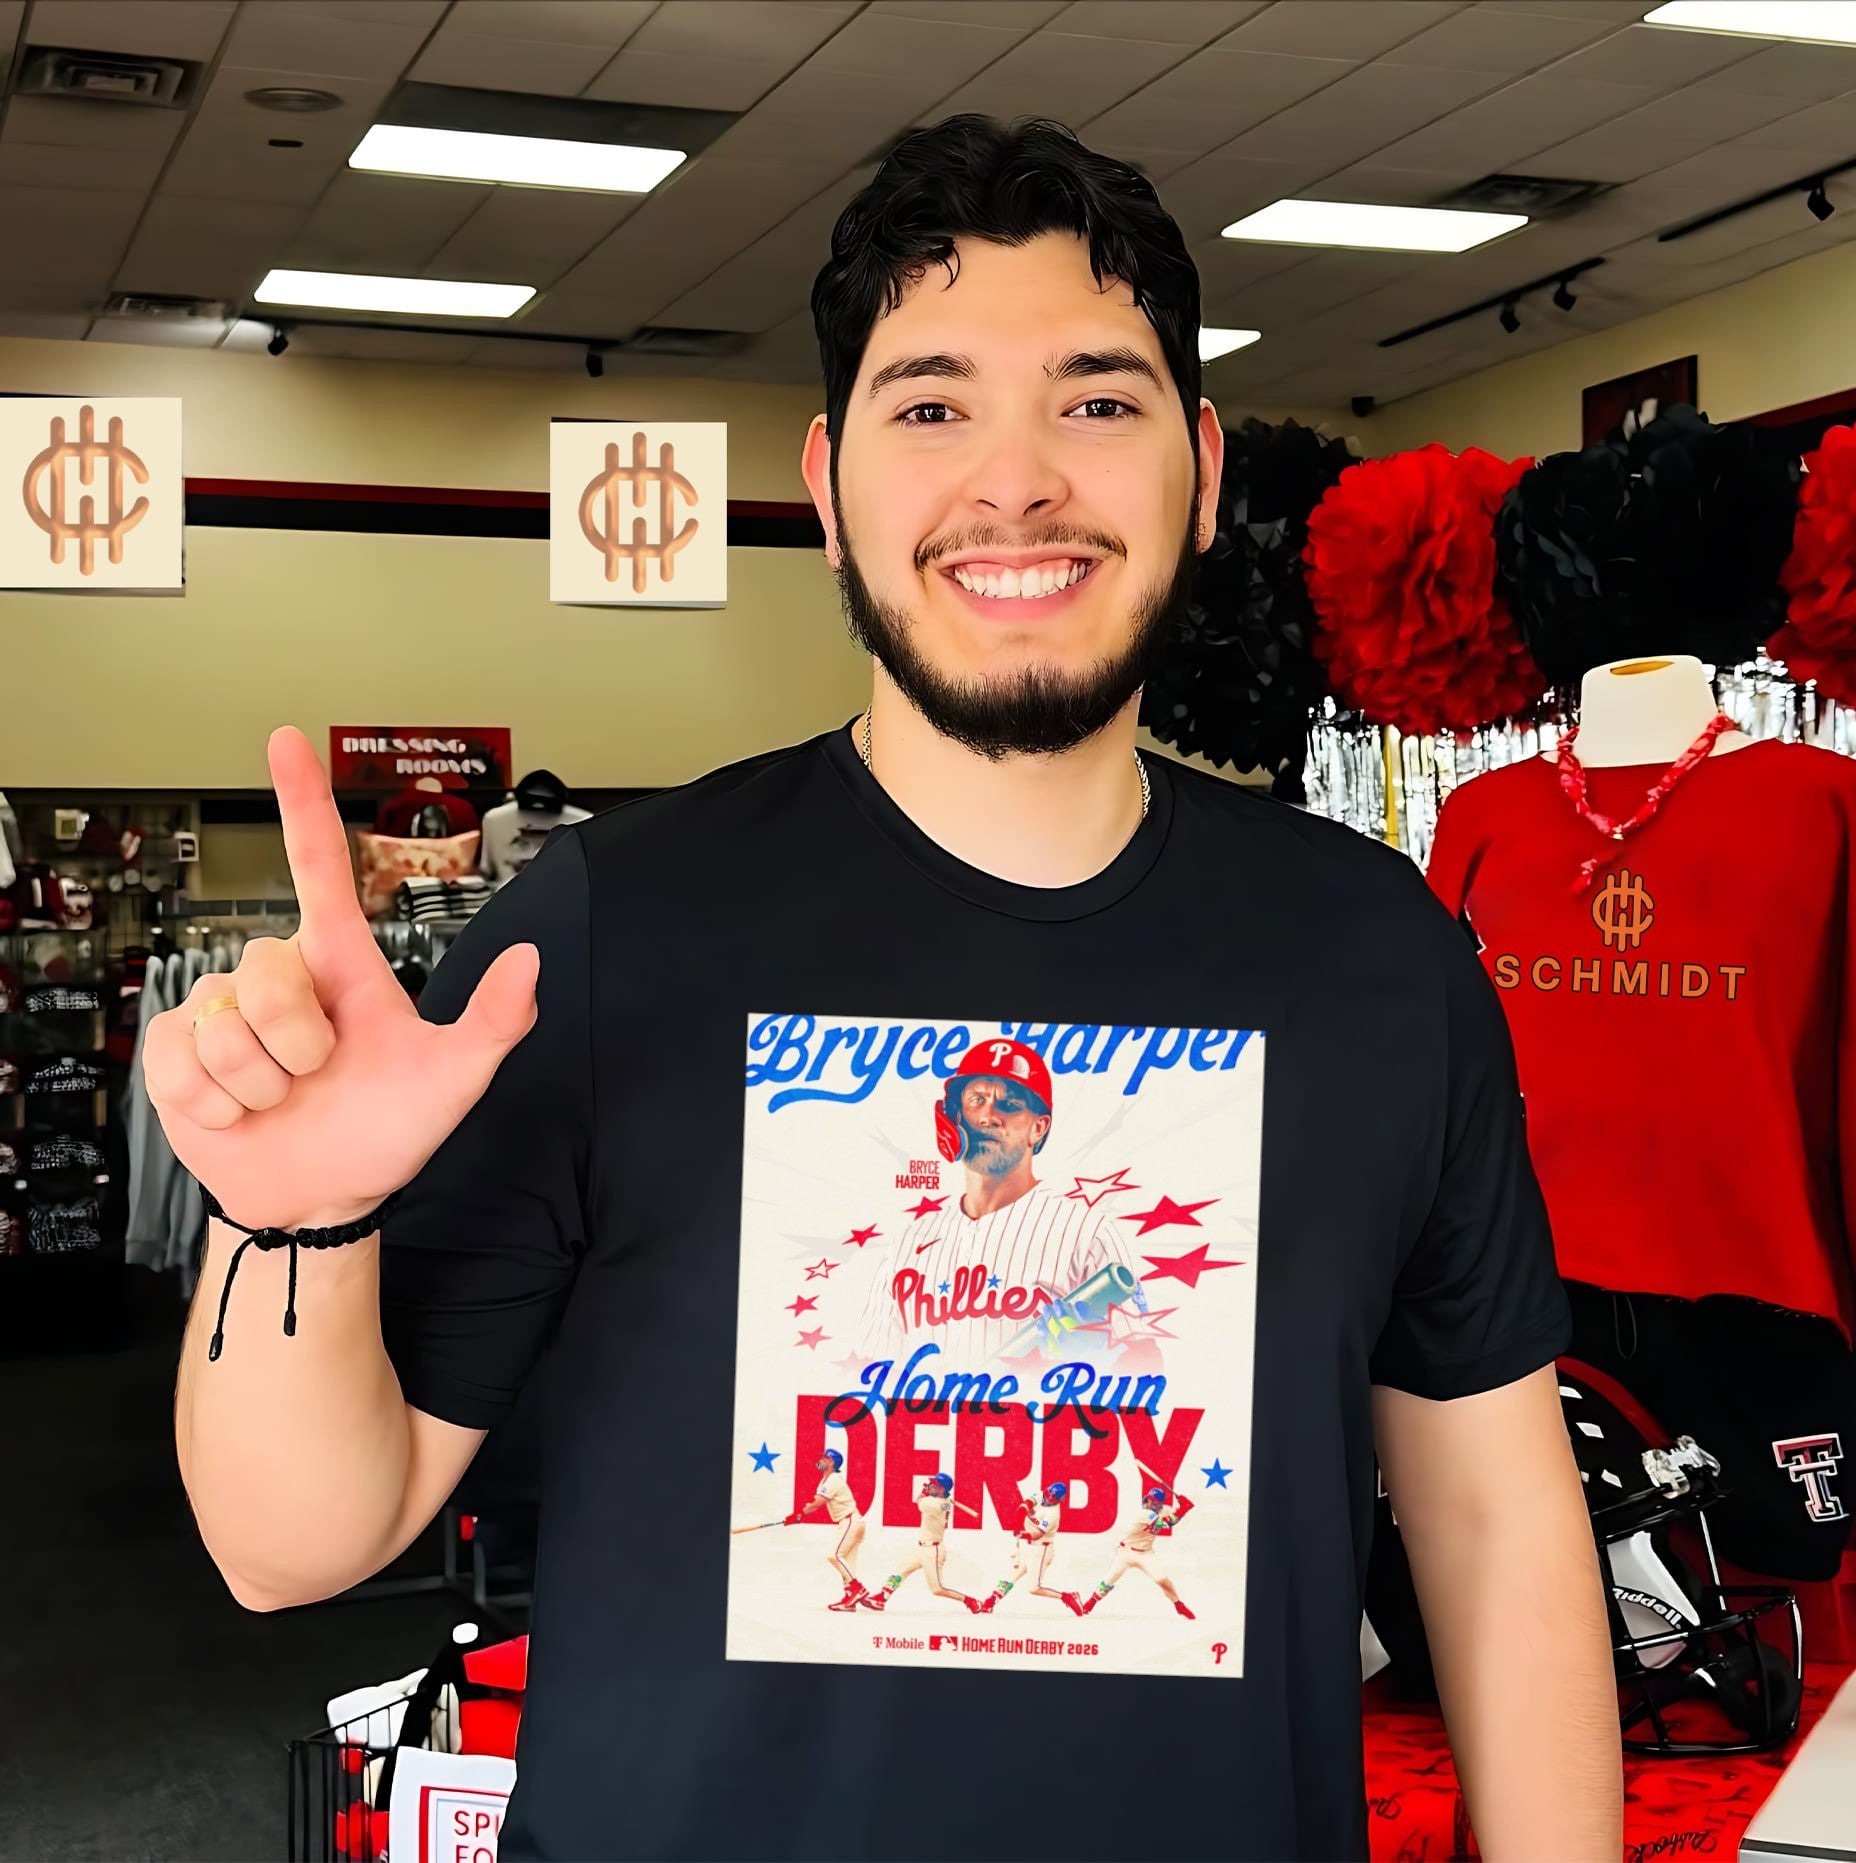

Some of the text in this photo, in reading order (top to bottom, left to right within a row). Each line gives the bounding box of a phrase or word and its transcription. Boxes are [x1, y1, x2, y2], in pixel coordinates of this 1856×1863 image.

[342, 737, 467, 754] DRESSING
[396, 758, 487, 775] ROOMS
[1494, 953, 1746, 1000] SCHMIDT
[745, 1013, 971, 1114] Bryce
[895, 1174, 940, 1190] HARPER
[909, 1159, 941, 1175] BRYCE
[892, 1264, 1054, 1335] Phillies
[824, 1343, 1168, 1440] Home Run
[793, 1394, 1206, 1538] DERBY
[885, 1636, 925, 1650] Mobile
[1067, 1643, 1099, 1656] 2026
